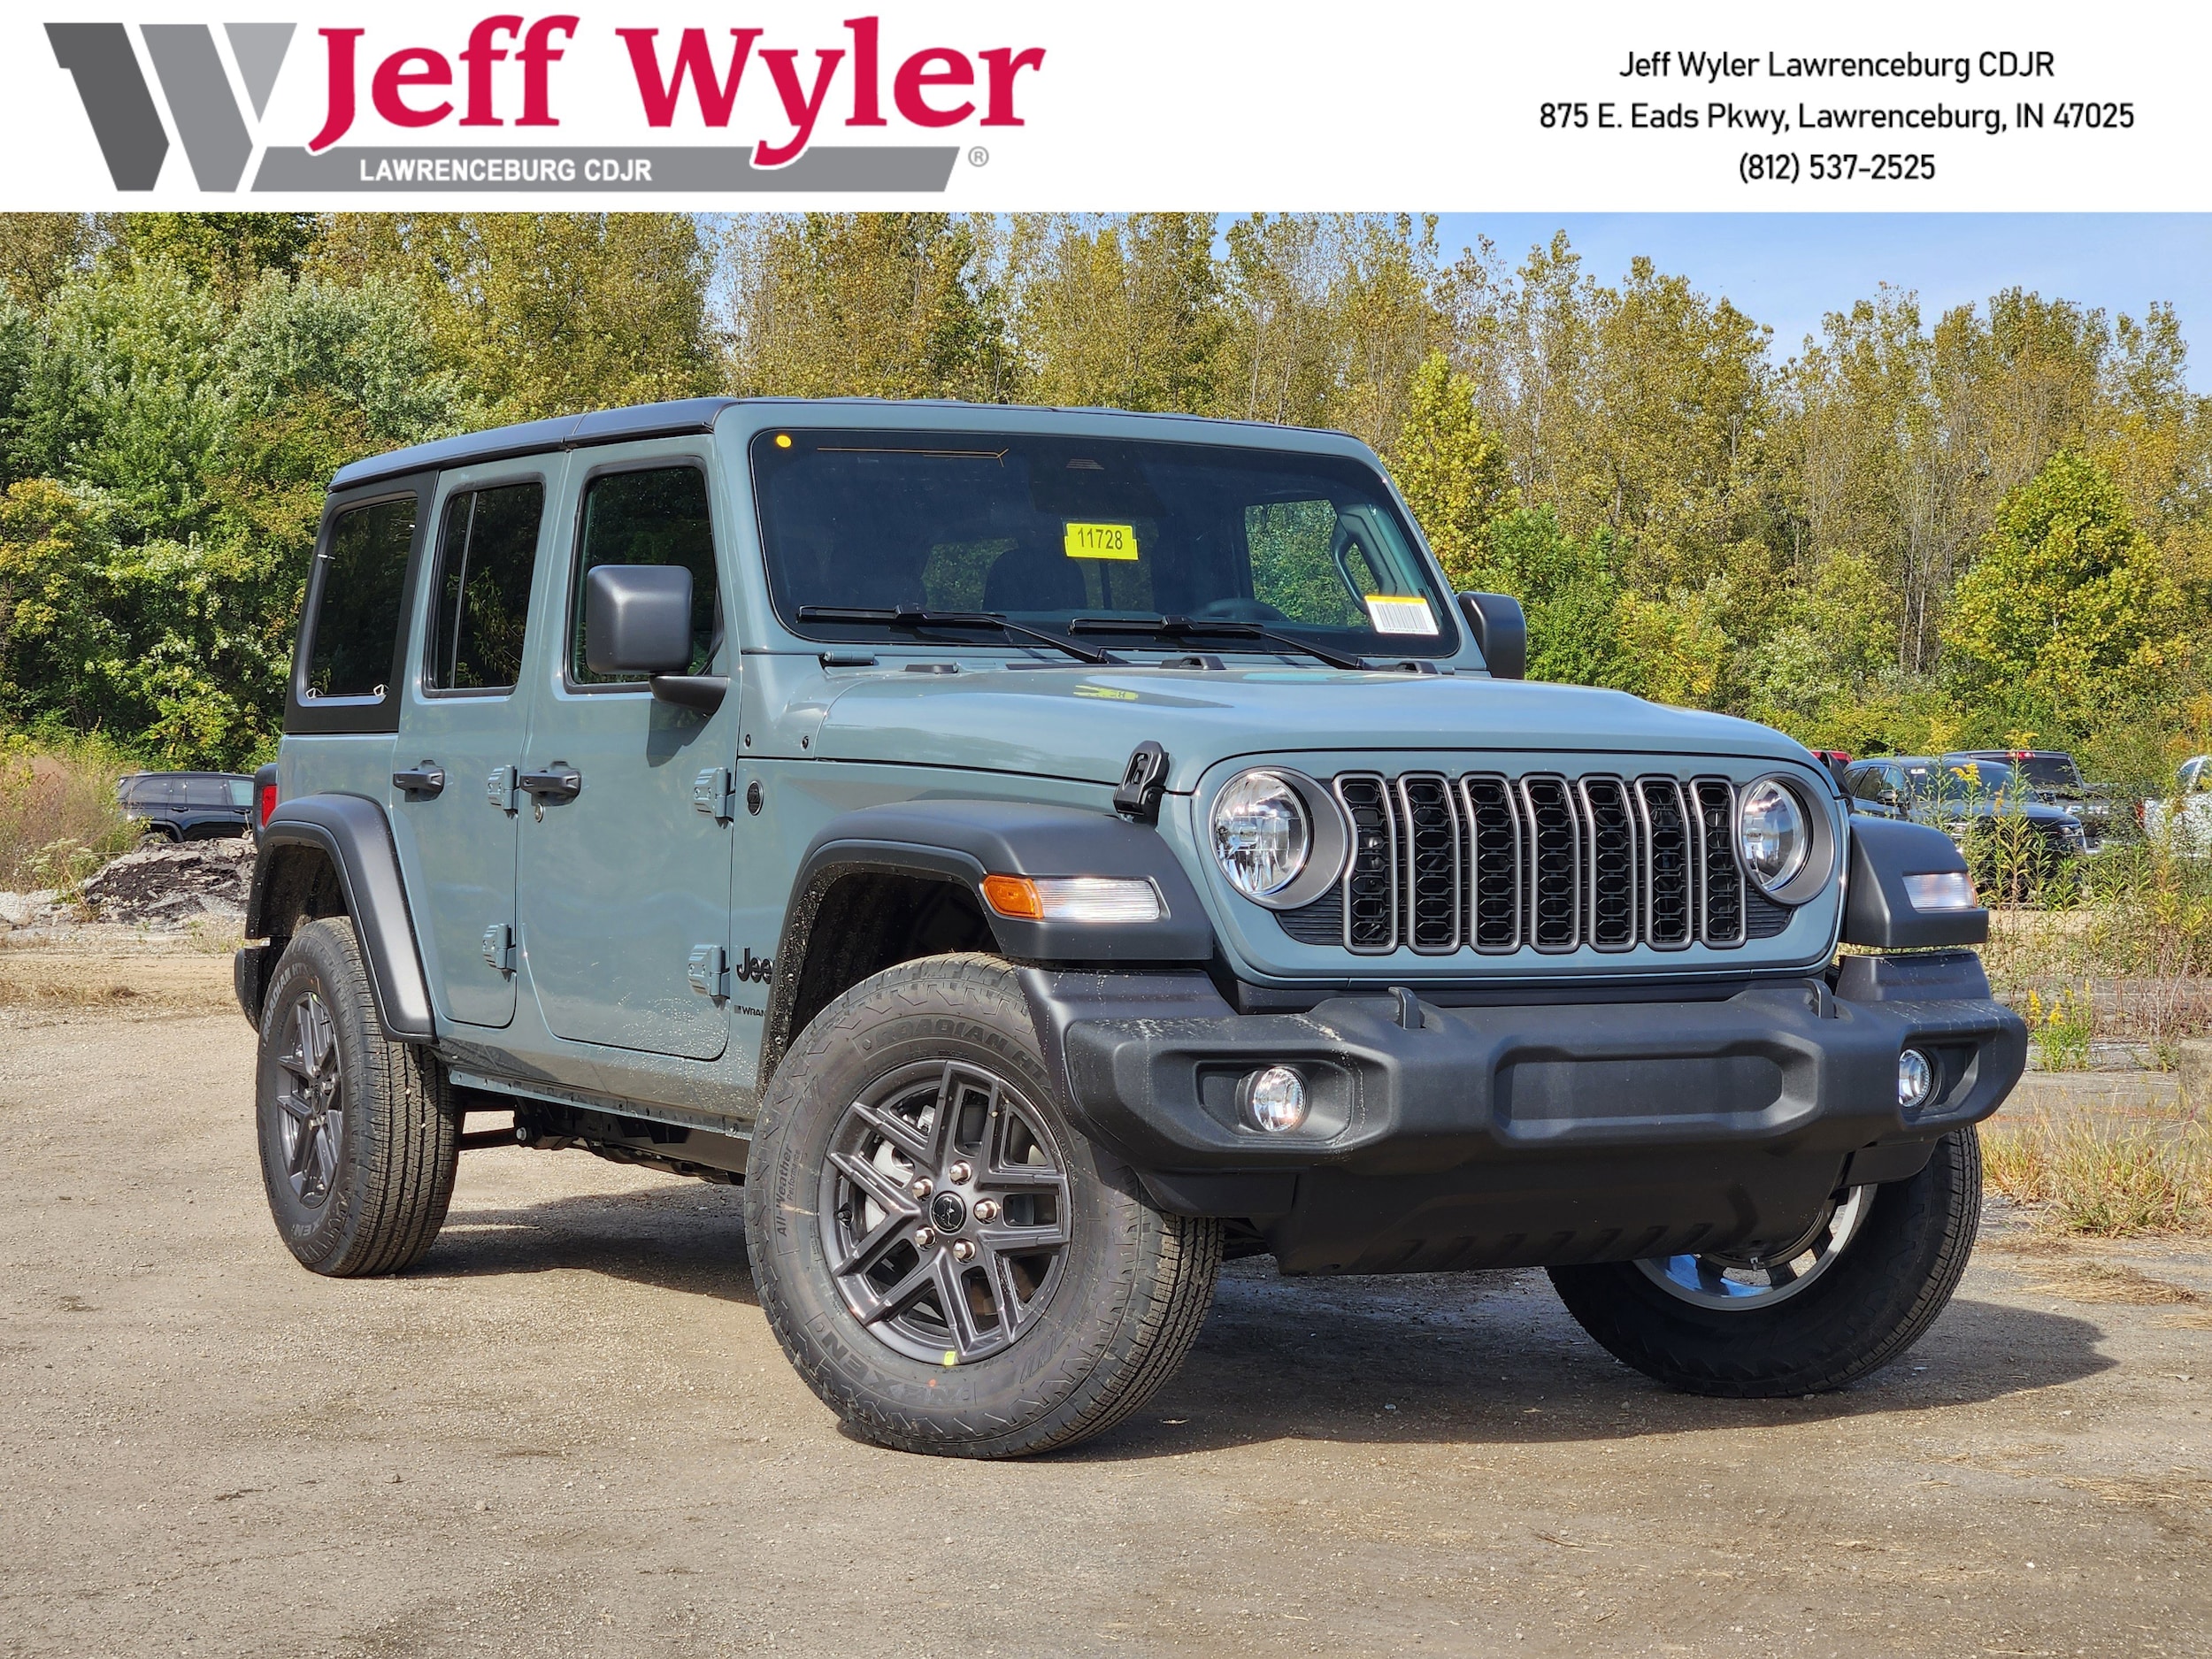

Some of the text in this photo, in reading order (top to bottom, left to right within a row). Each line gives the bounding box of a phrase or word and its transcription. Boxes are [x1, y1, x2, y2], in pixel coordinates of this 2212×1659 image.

[1078, 527, 1123, 550] 11728
[736, 947, 774, 985] Jee
[263, 967, 292, 1043] ROADIAN
[741, 1007, 766, 1018] WRAN
[875, 1018, 1010, 1053] ROADIAN
